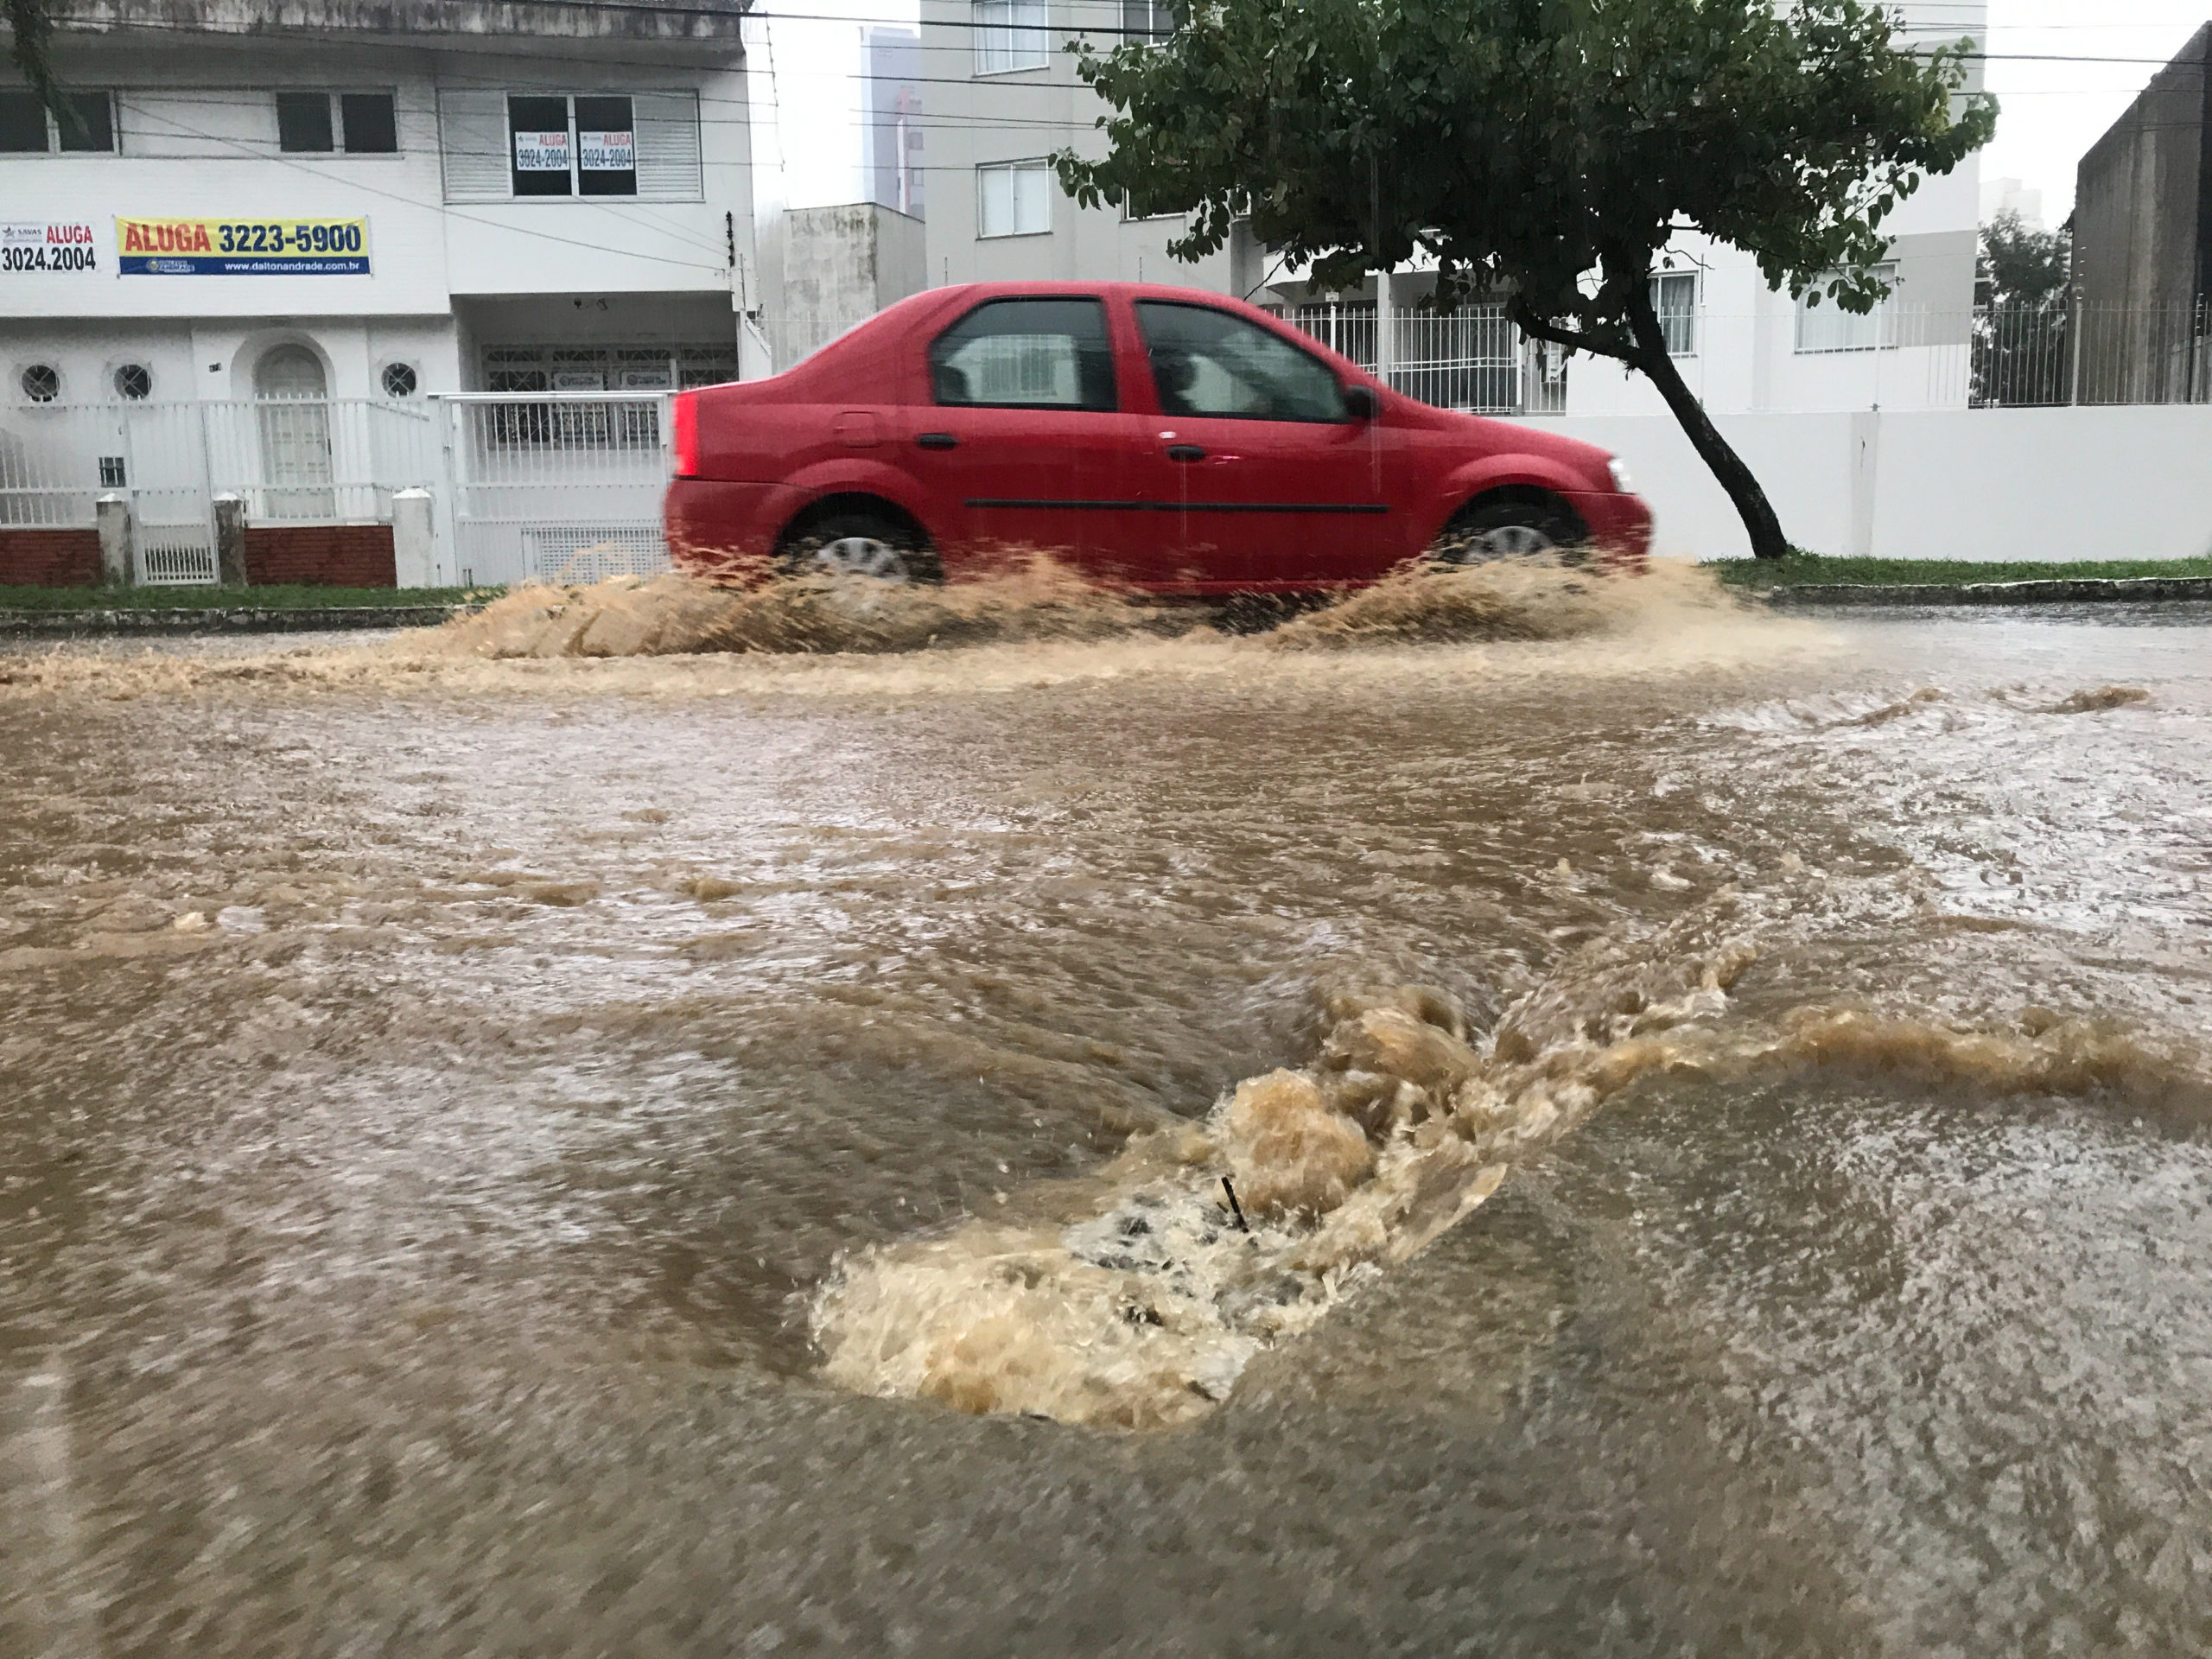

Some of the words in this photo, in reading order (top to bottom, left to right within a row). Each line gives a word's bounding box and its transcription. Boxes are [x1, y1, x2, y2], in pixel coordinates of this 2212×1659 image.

[539, 134, 567, 146] ALUGA
[603, 134, 632, 145] ALUGA
[518, 149, 568, 168] 3024-2004
[582, 149, 632, 167] 3024-2004
[46, 226, 94, 244] ALUGA
[125, 223, 212, 251] ALUGA
[219, 225, 361, 252] 3223-5900
[1, 246, 96, 271] 3024.2004
[225, 262, 359, 271] www.daltonandrade.com.br
